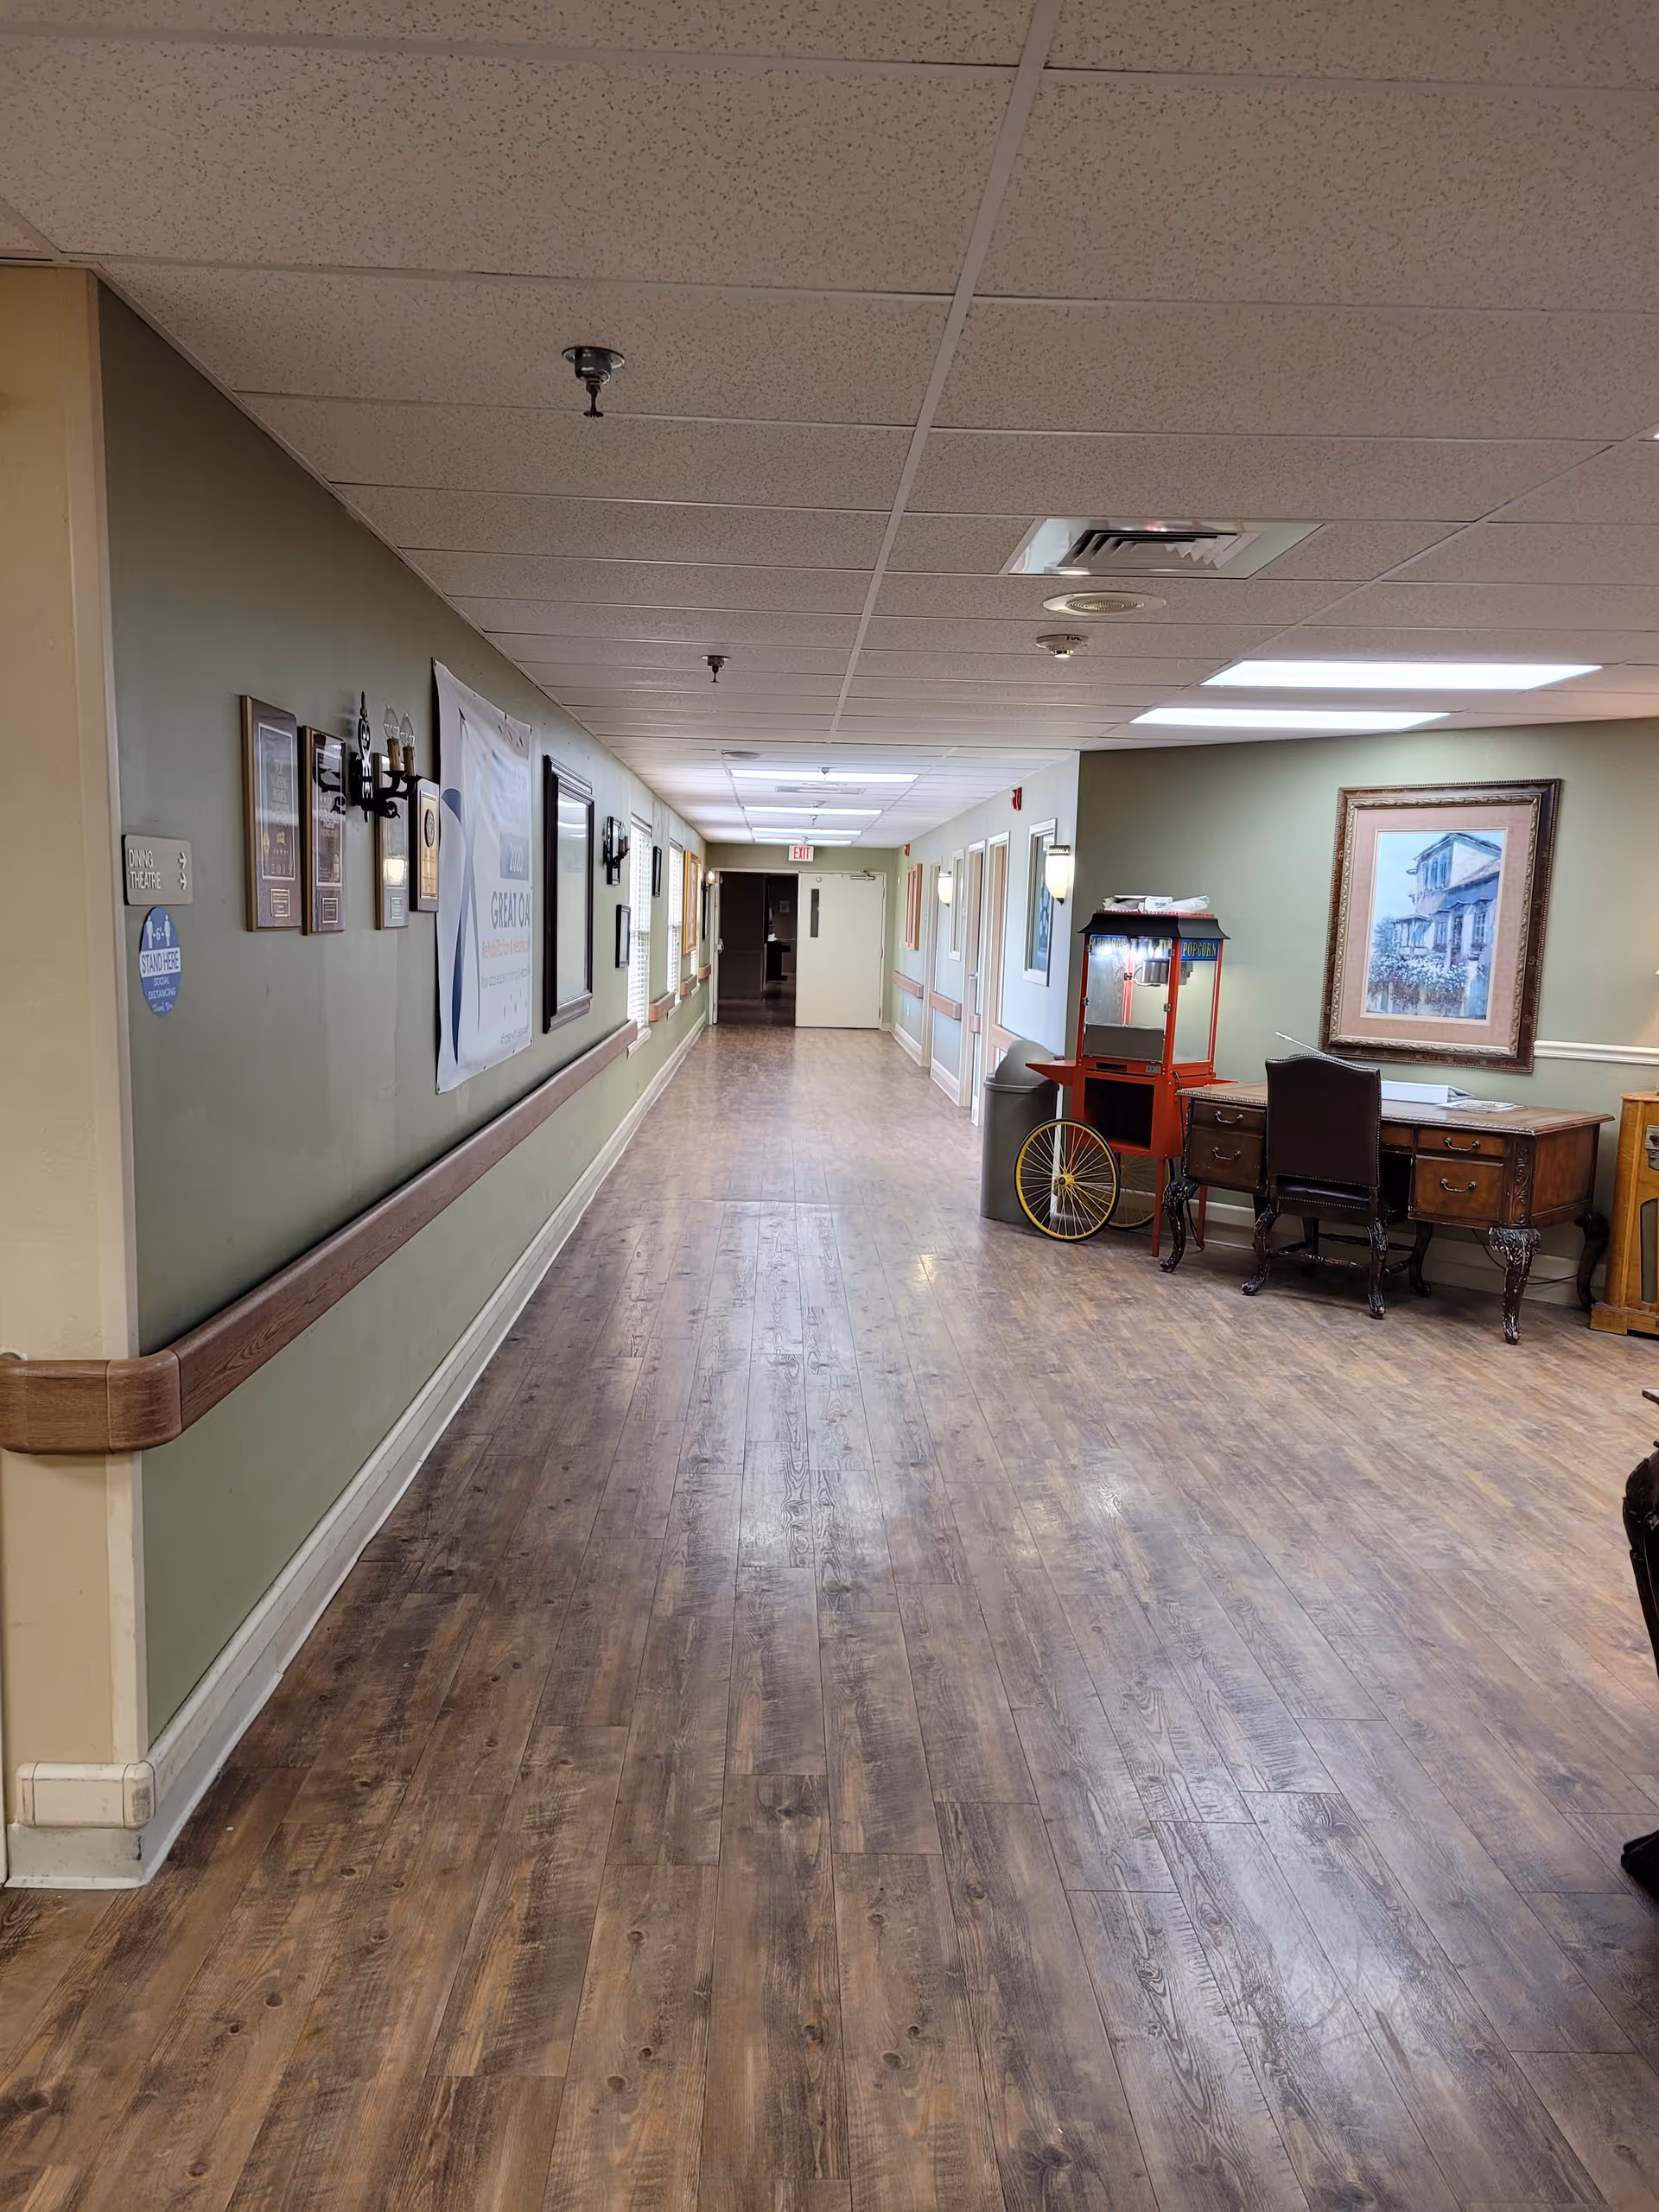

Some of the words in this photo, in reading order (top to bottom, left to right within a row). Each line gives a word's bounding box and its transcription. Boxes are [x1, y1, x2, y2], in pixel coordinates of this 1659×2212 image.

[128, 849, 154, 868] DINING
[509, 843, 524, 873] 2020
[793, 846, 810, 860] EXIT
[130, 870, 162, 889] THEATRE
[491, 890, 517, 929] GREAT
[1181, 941, 1217, 957] POPCORN
[141, 953, 162, 975] STAND
[163, 950, 180, 971] HERE
[153, 976, 171, 987] SOCIAL
[148, 986, 176, 1001] DISTANCING
